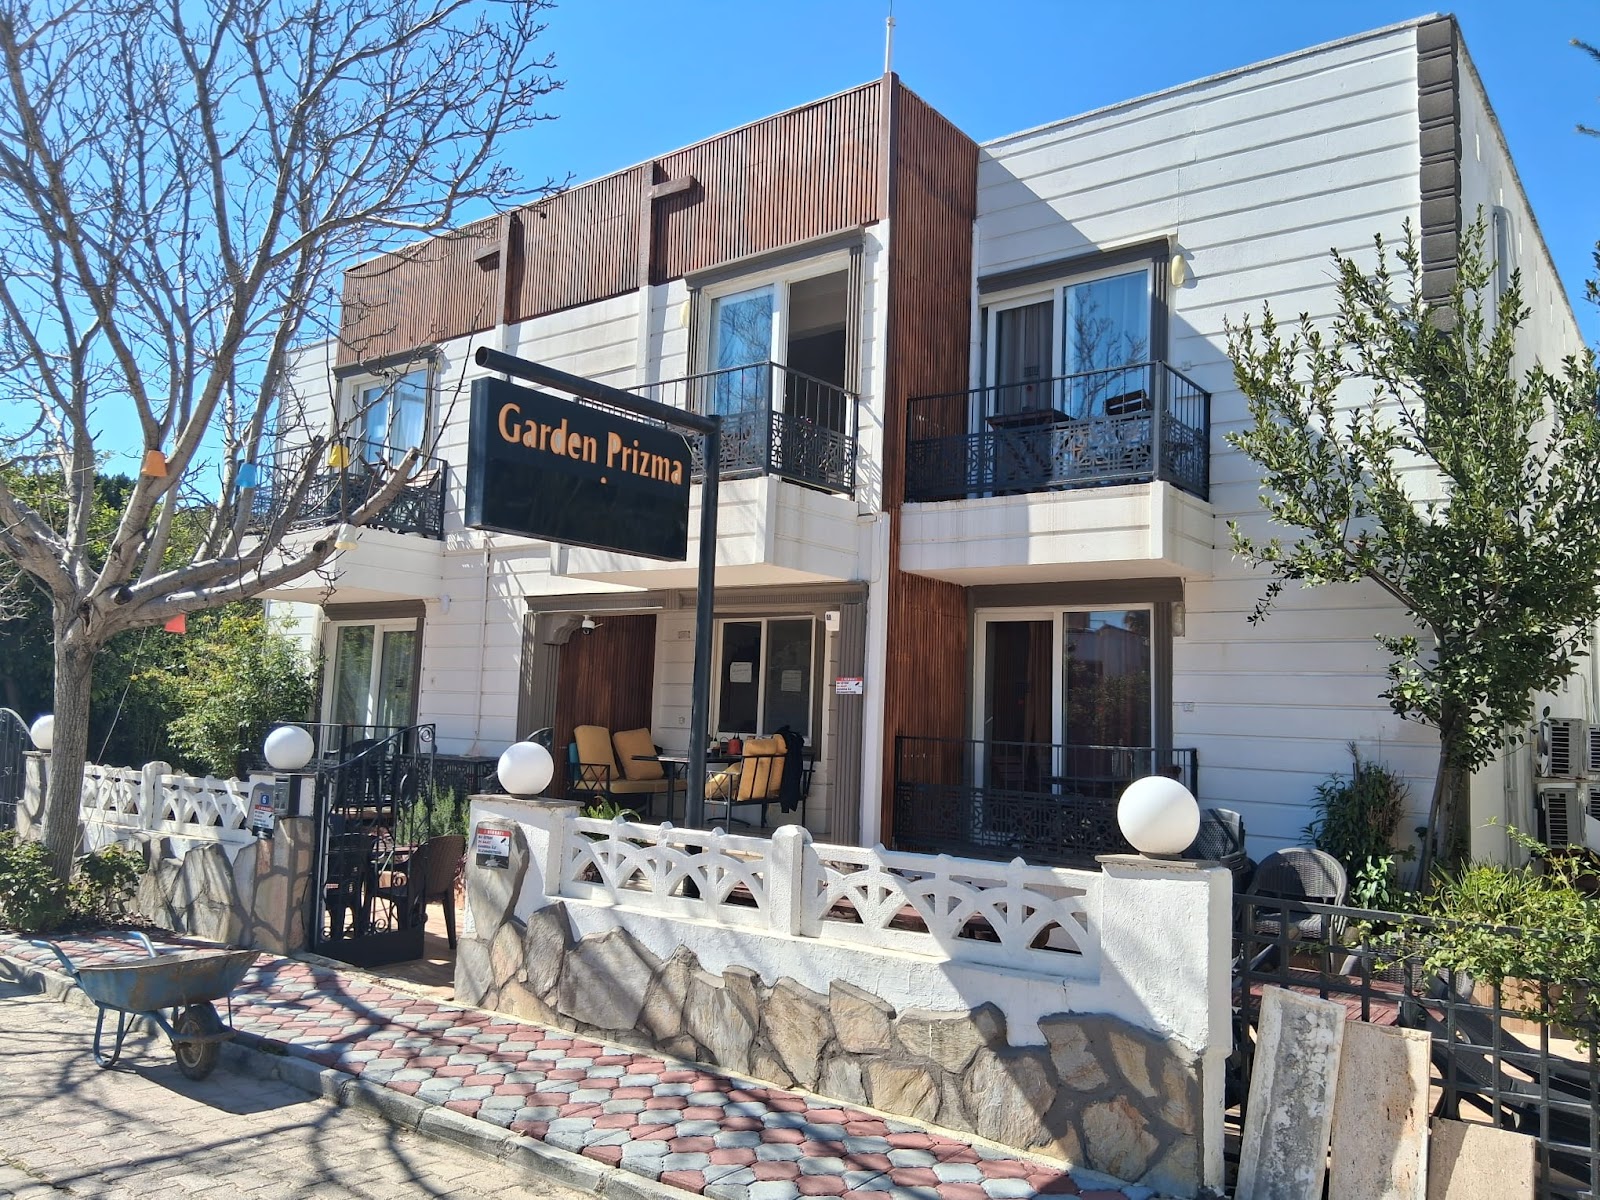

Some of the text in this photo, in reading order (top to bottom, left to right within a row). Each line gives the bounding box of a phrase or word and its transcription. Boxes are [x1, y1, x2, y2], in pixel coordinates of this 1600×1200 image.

[498, 402, 683, 485] Garden Prizma
[262, 795, 267, 804] 6
